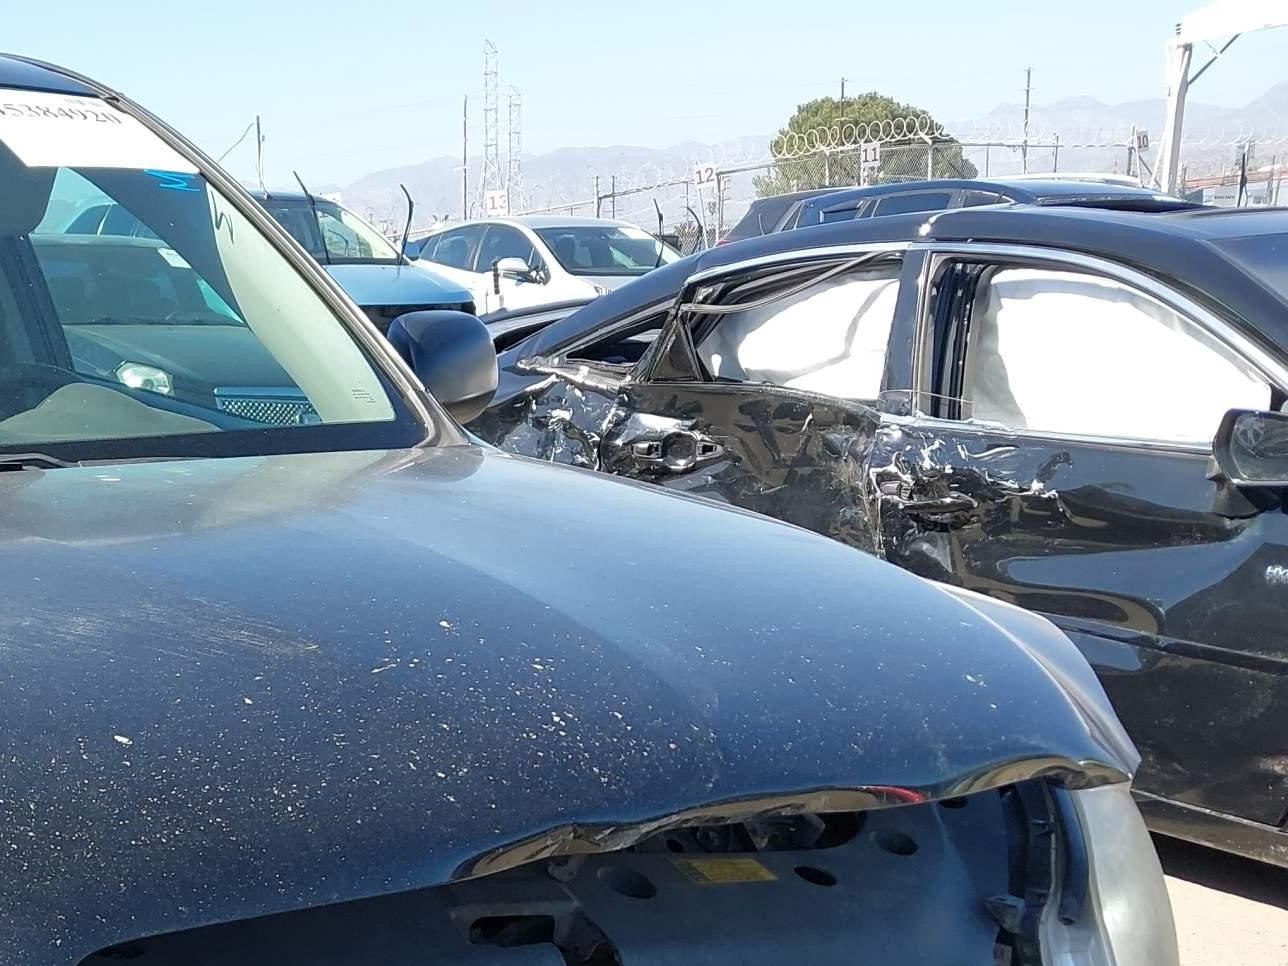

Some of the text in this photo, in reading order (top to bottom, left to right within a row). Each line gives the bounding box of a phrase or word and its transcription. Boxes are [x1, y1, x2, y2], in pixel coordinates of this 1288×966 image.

[862, 146, 879, 163] 11
[695, 167, 715, 185] 12
[488, 194, 507, 210] 13
